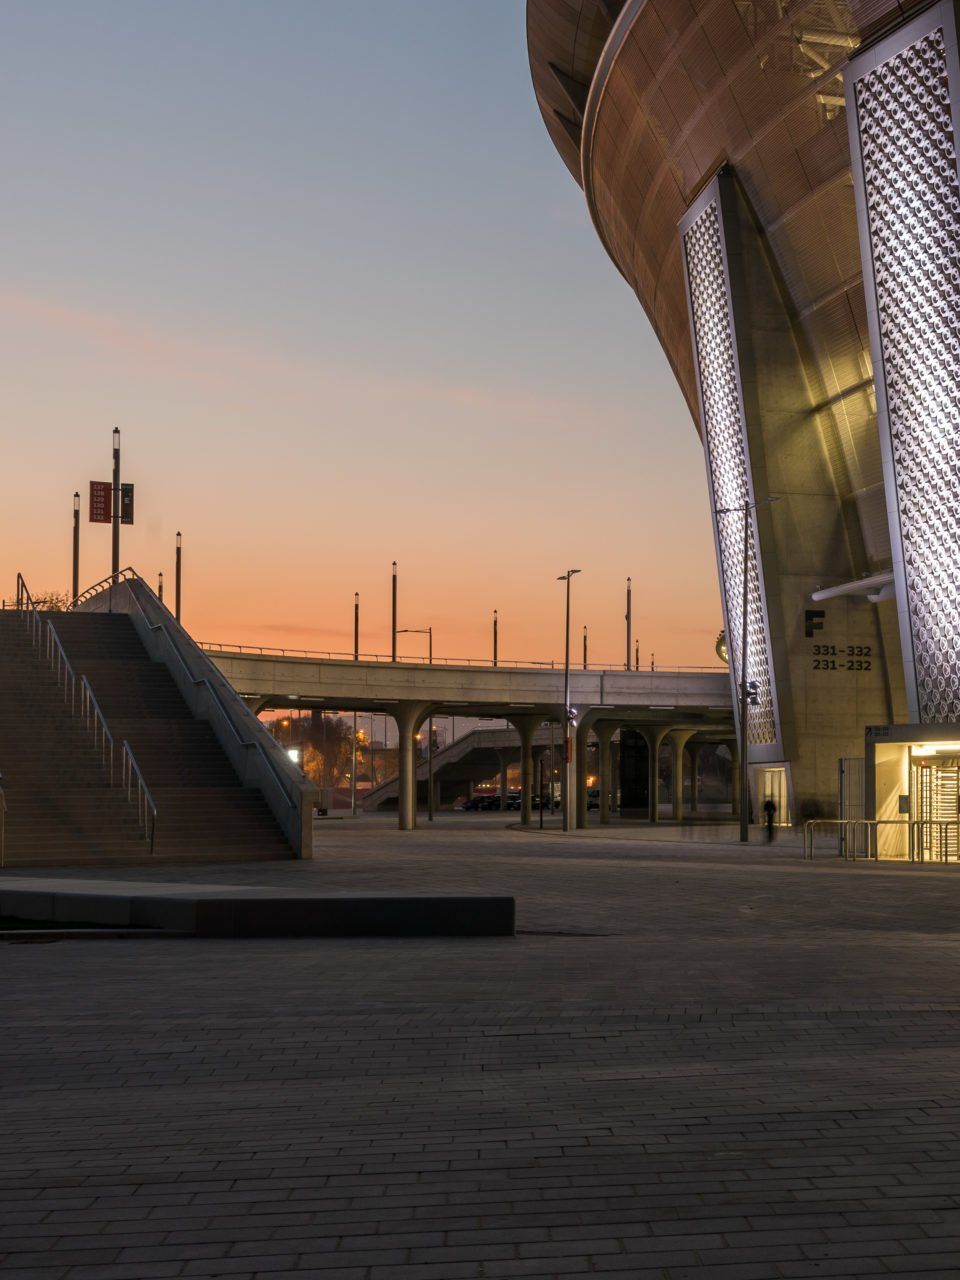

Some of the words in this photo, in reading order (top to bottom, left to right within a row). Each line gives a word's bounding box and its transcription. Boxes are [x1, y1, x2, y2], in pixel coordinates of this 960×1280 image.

[805, 610, 825, 637] F
[812, 645, 872, 657] 331-332
[812, 659, 872, 671] 231-232
